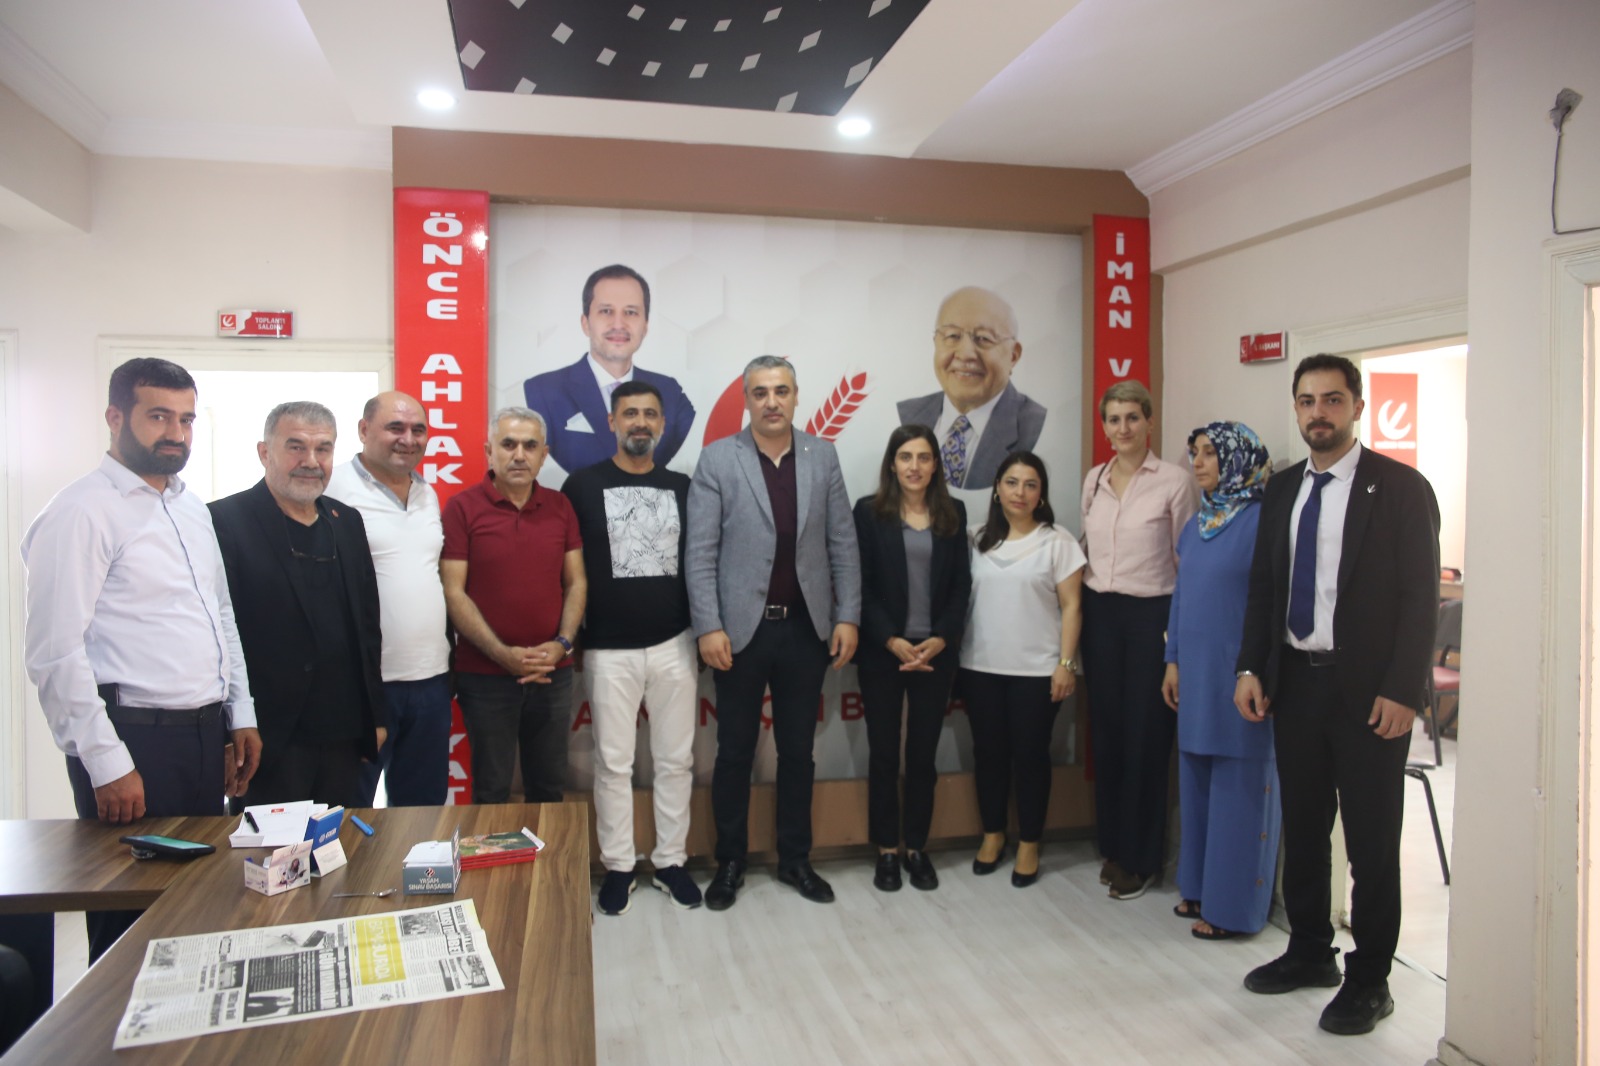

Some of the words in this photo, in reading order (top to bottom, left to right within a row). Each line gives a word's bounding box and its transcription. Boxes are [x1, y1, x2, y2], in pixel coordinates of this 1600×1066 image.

[422, 211, 463, 320] ÖNCE
[1107, 232, 1133, 328] İMAN
[420, 353, 463, 484] AHLAK
